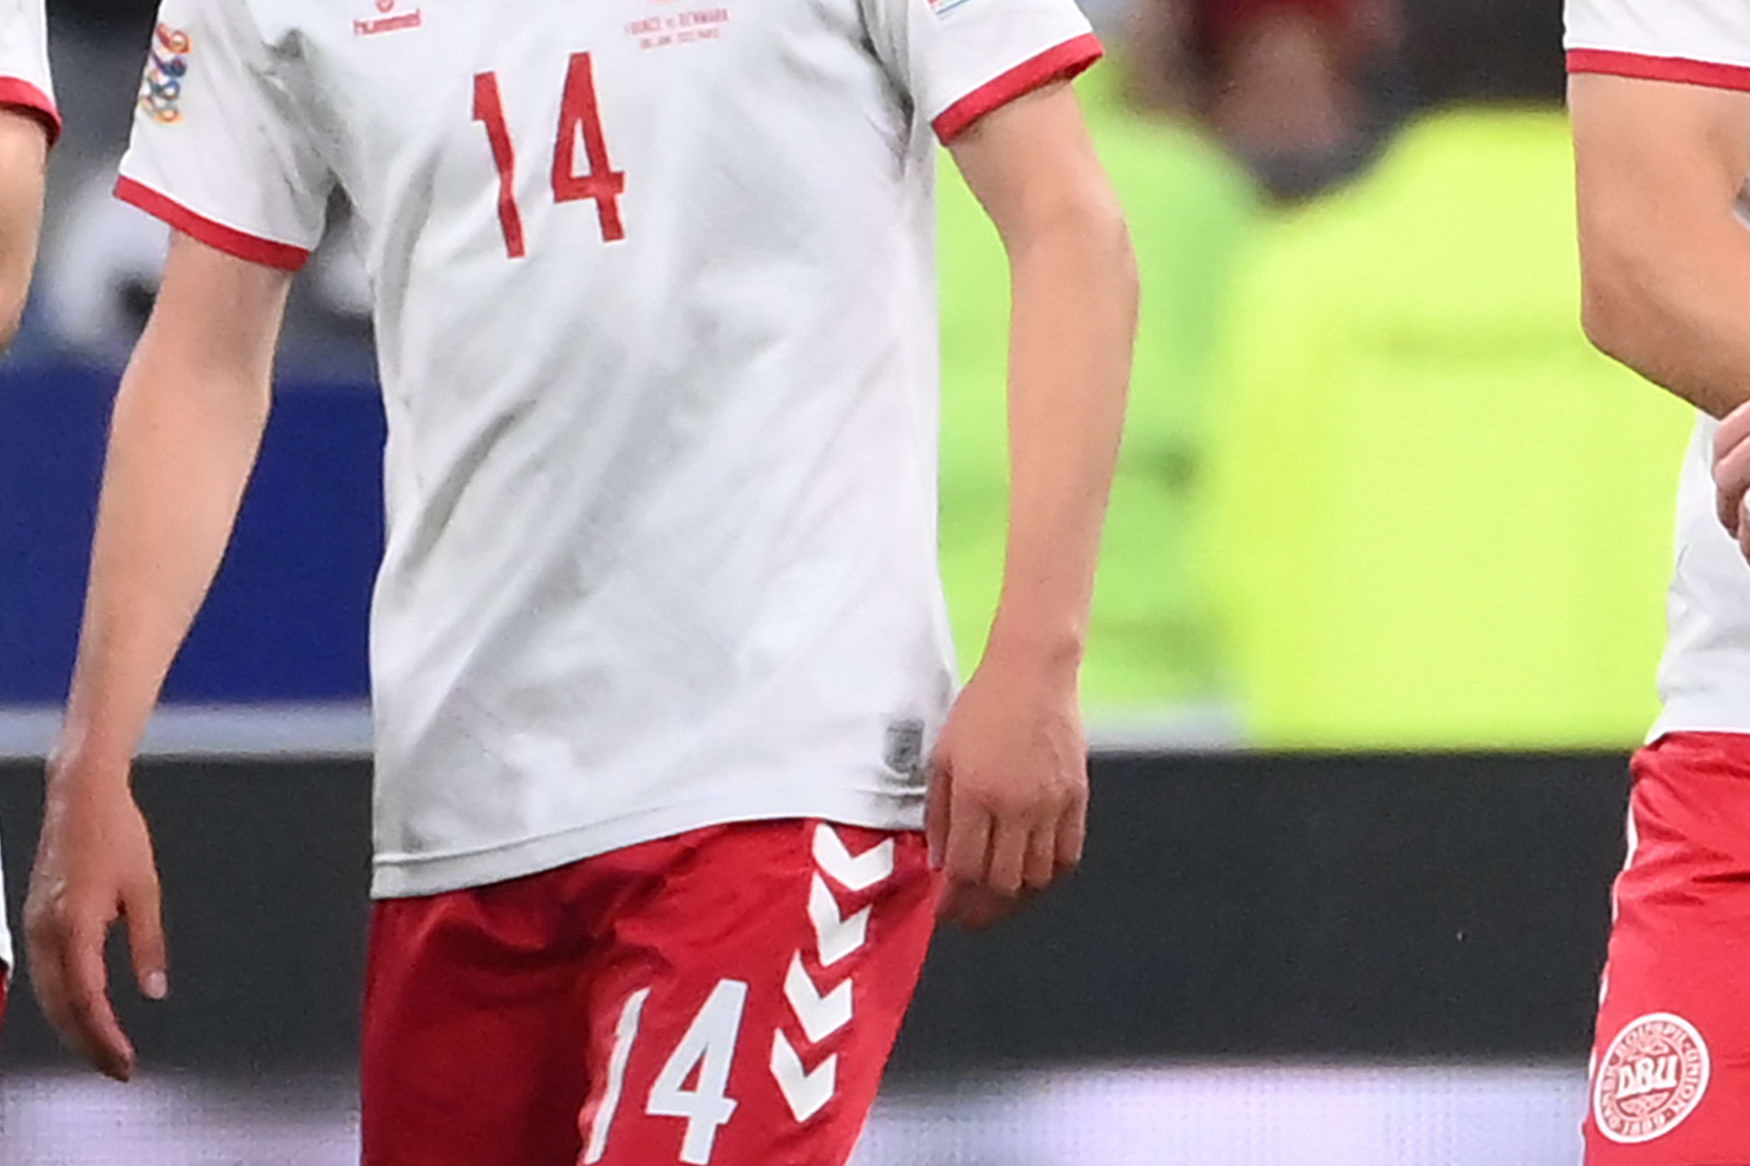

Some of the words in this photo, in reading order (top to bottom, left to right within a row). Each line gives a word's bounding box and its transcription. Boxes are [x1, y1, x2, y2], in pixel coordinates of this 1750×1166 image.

[353, 8, 421, 36] hummel
[472, 52, 626, 259] 14
[584, 978, 749, 1165] 14
[1616, 1054, 1678, 1099] DBU
